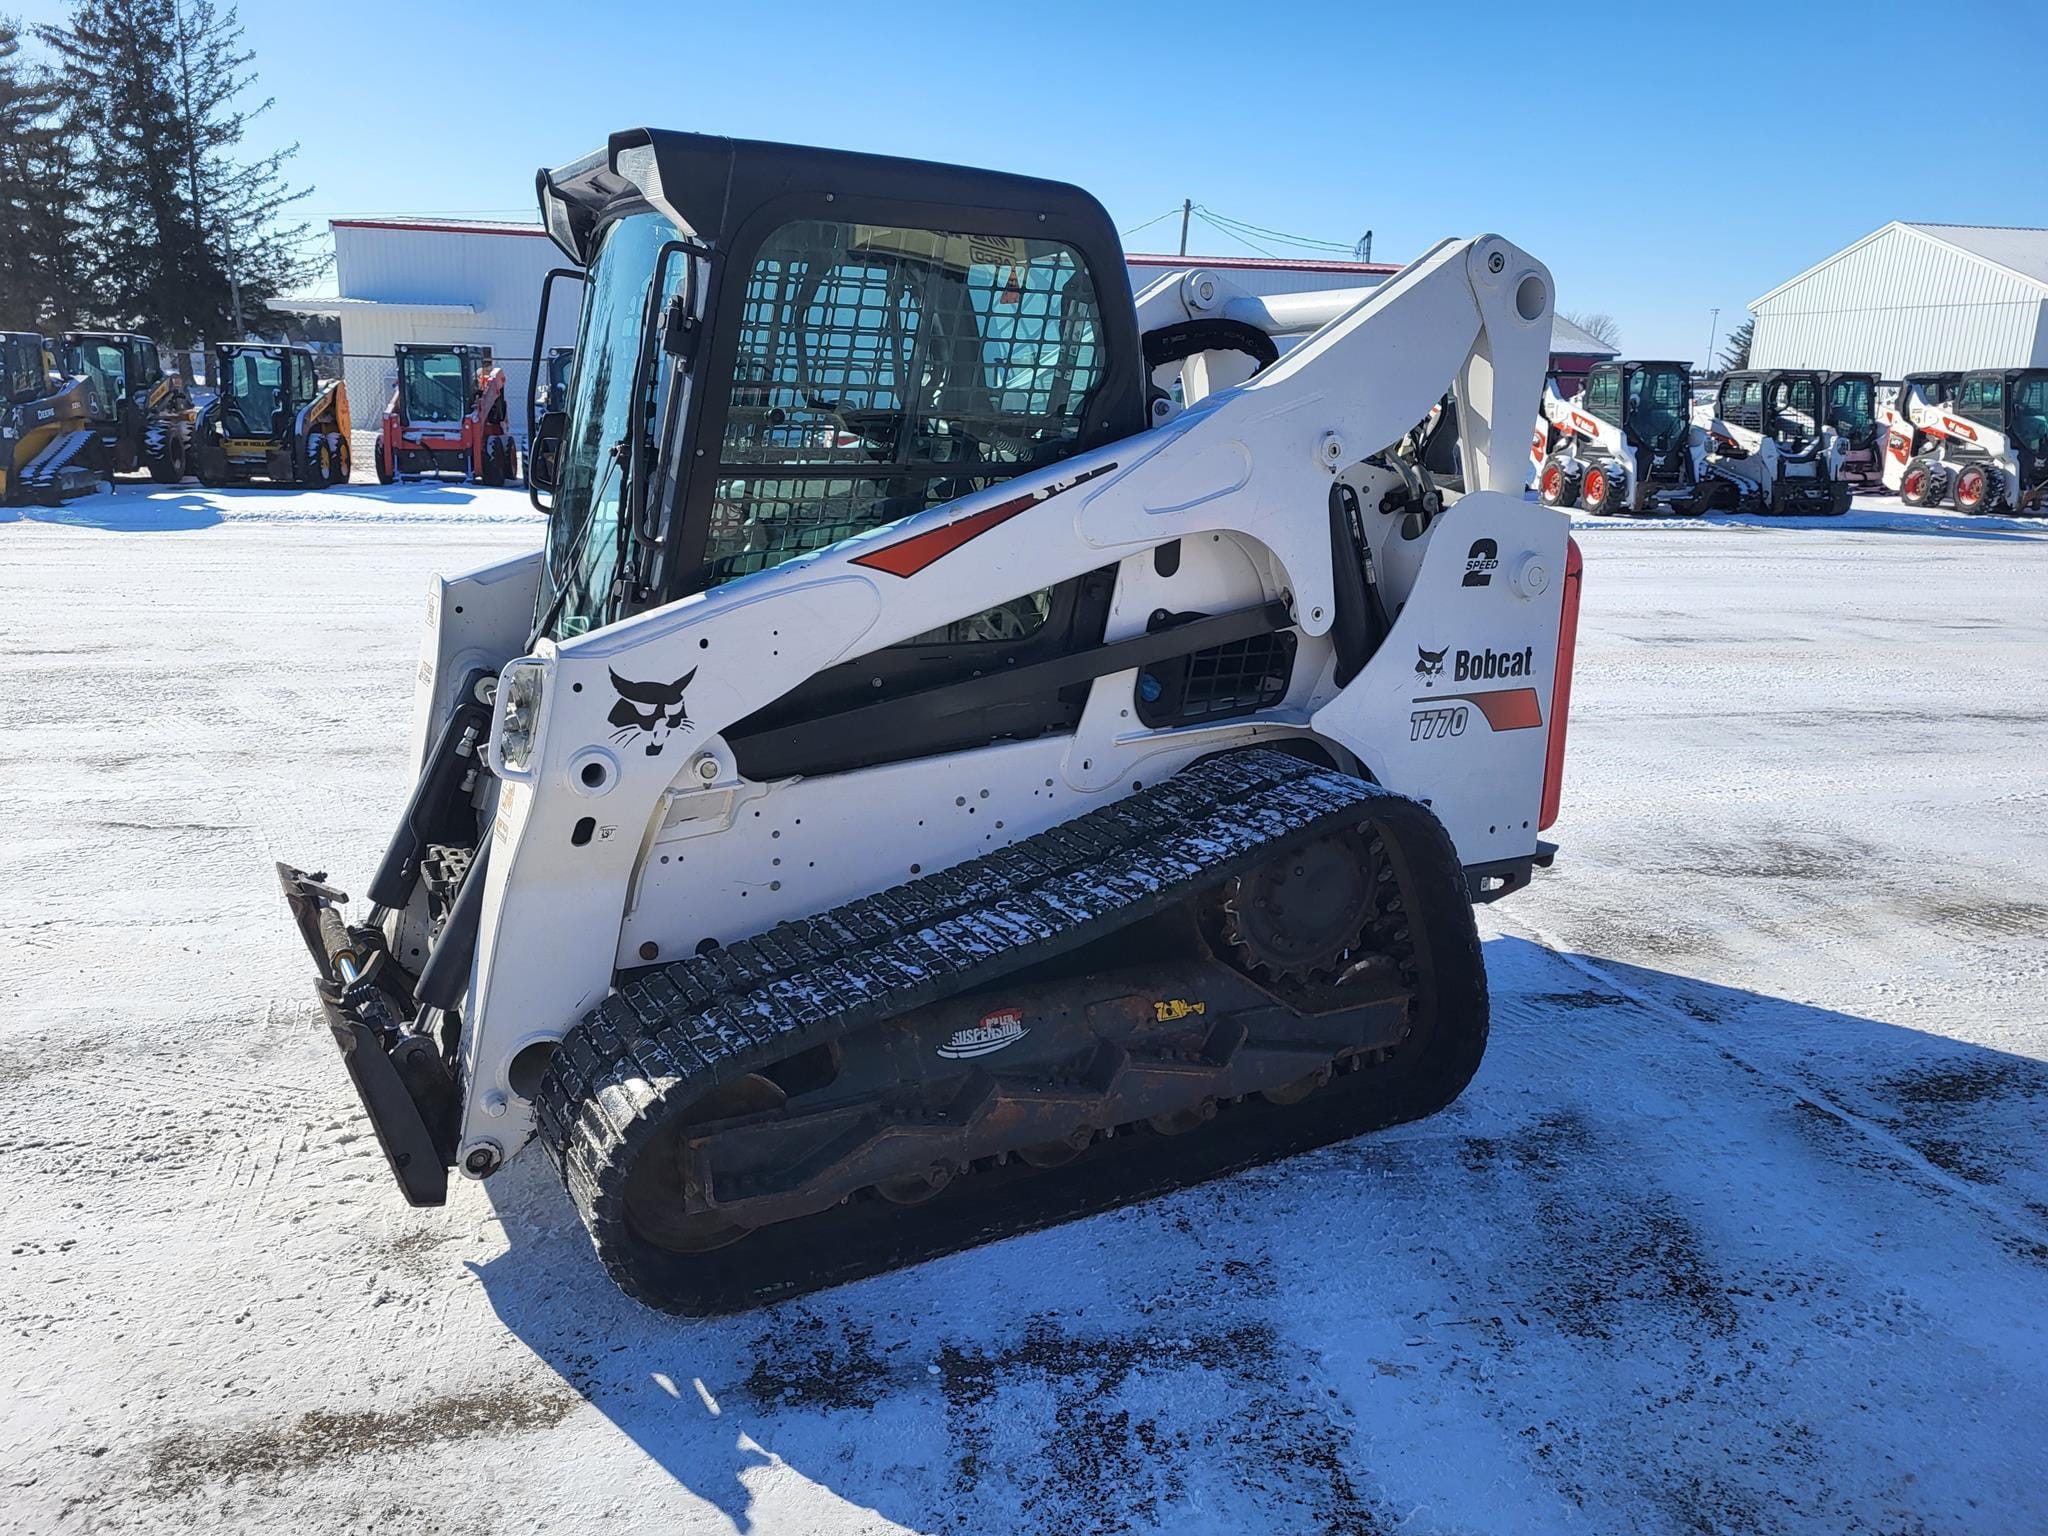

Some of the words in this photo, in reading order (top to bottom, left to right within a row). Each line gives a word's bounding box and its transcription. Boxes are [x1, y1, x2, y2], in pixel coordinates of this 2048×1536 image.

[37, 407, 55, 420] DEERE
[1465, 559, 1499, 571] SPEED
[1454, 646, 1533, 682] Bobcat
[1410, 706, 1469, 742] T770
[952, 1020, 1022, 1046] SUSPENSION
